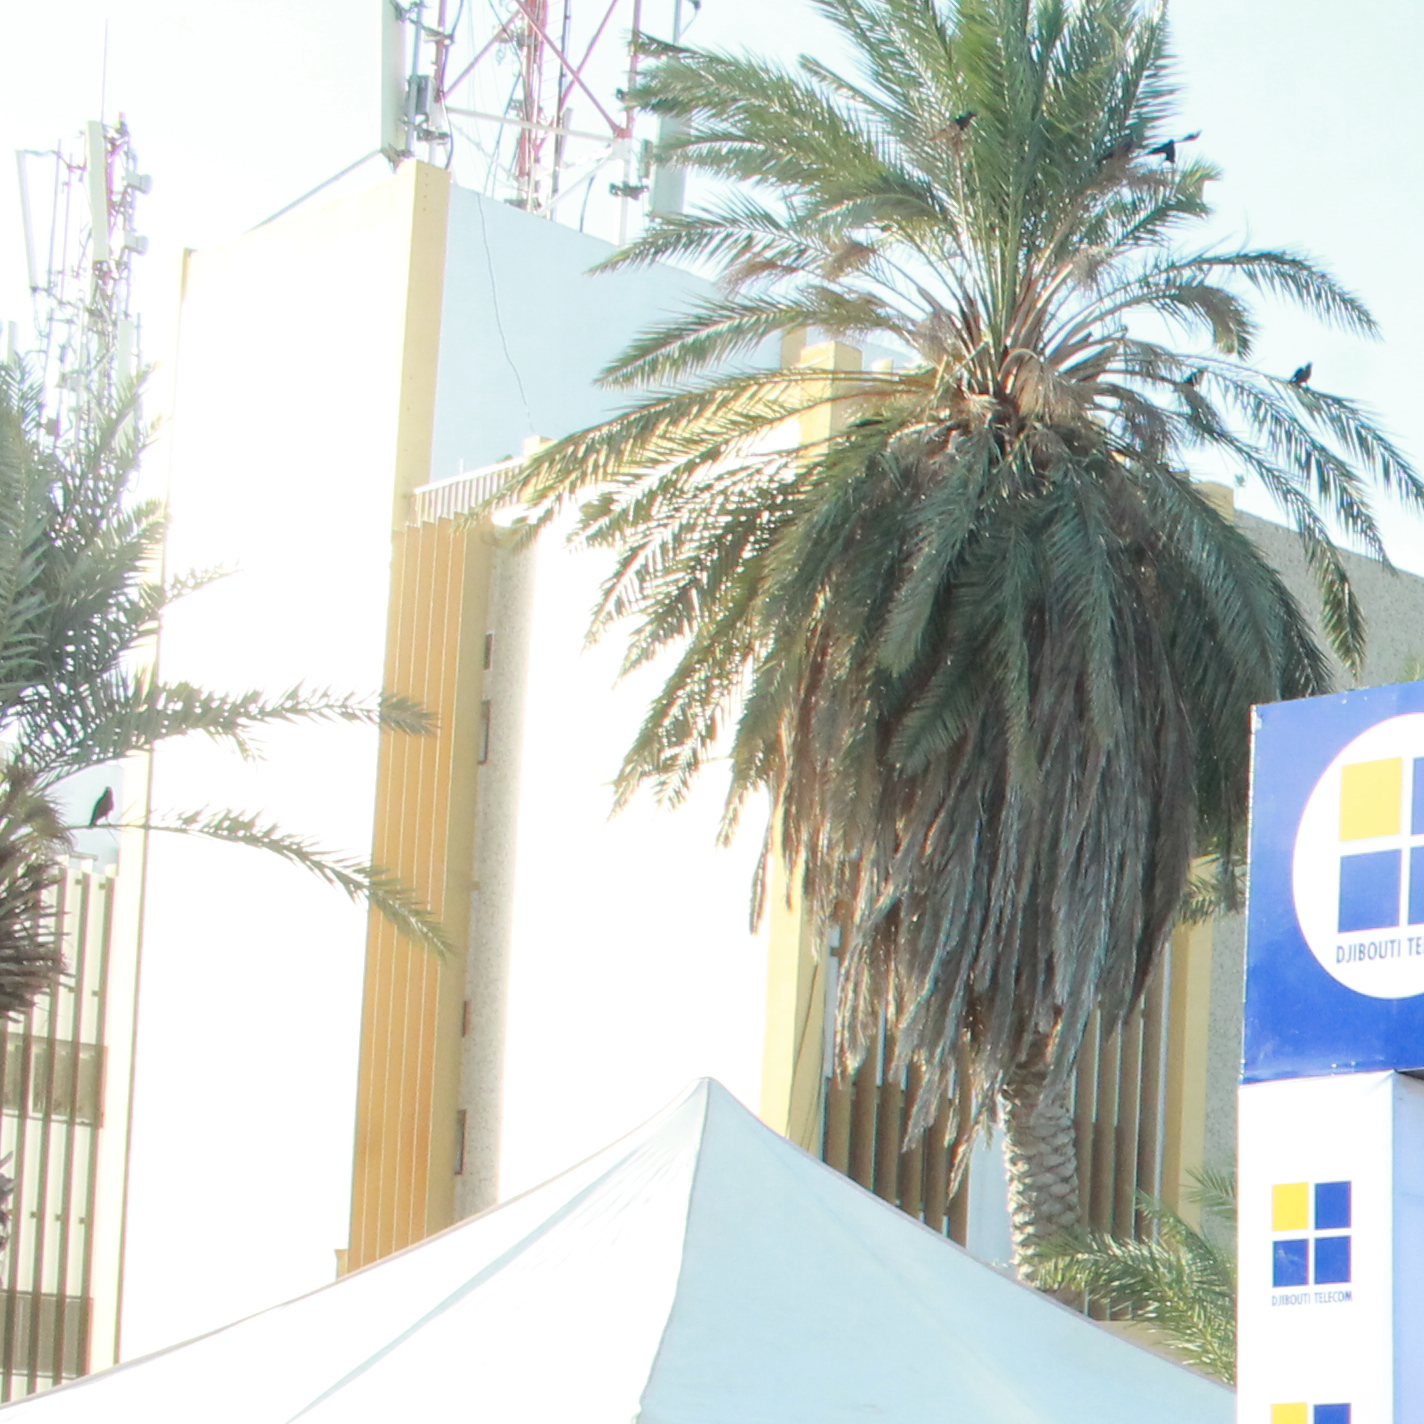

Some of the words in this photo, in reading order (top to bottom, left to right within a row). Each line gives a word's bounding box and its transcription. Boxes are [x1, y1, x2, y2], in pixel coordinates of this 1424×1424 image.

[1336, 939, 1402, 965] DJIBOUTI
[1271, 1292, 1311, 1307] DJIBOUTI
[1313, 1289, 1353, 1305] TELECOM
